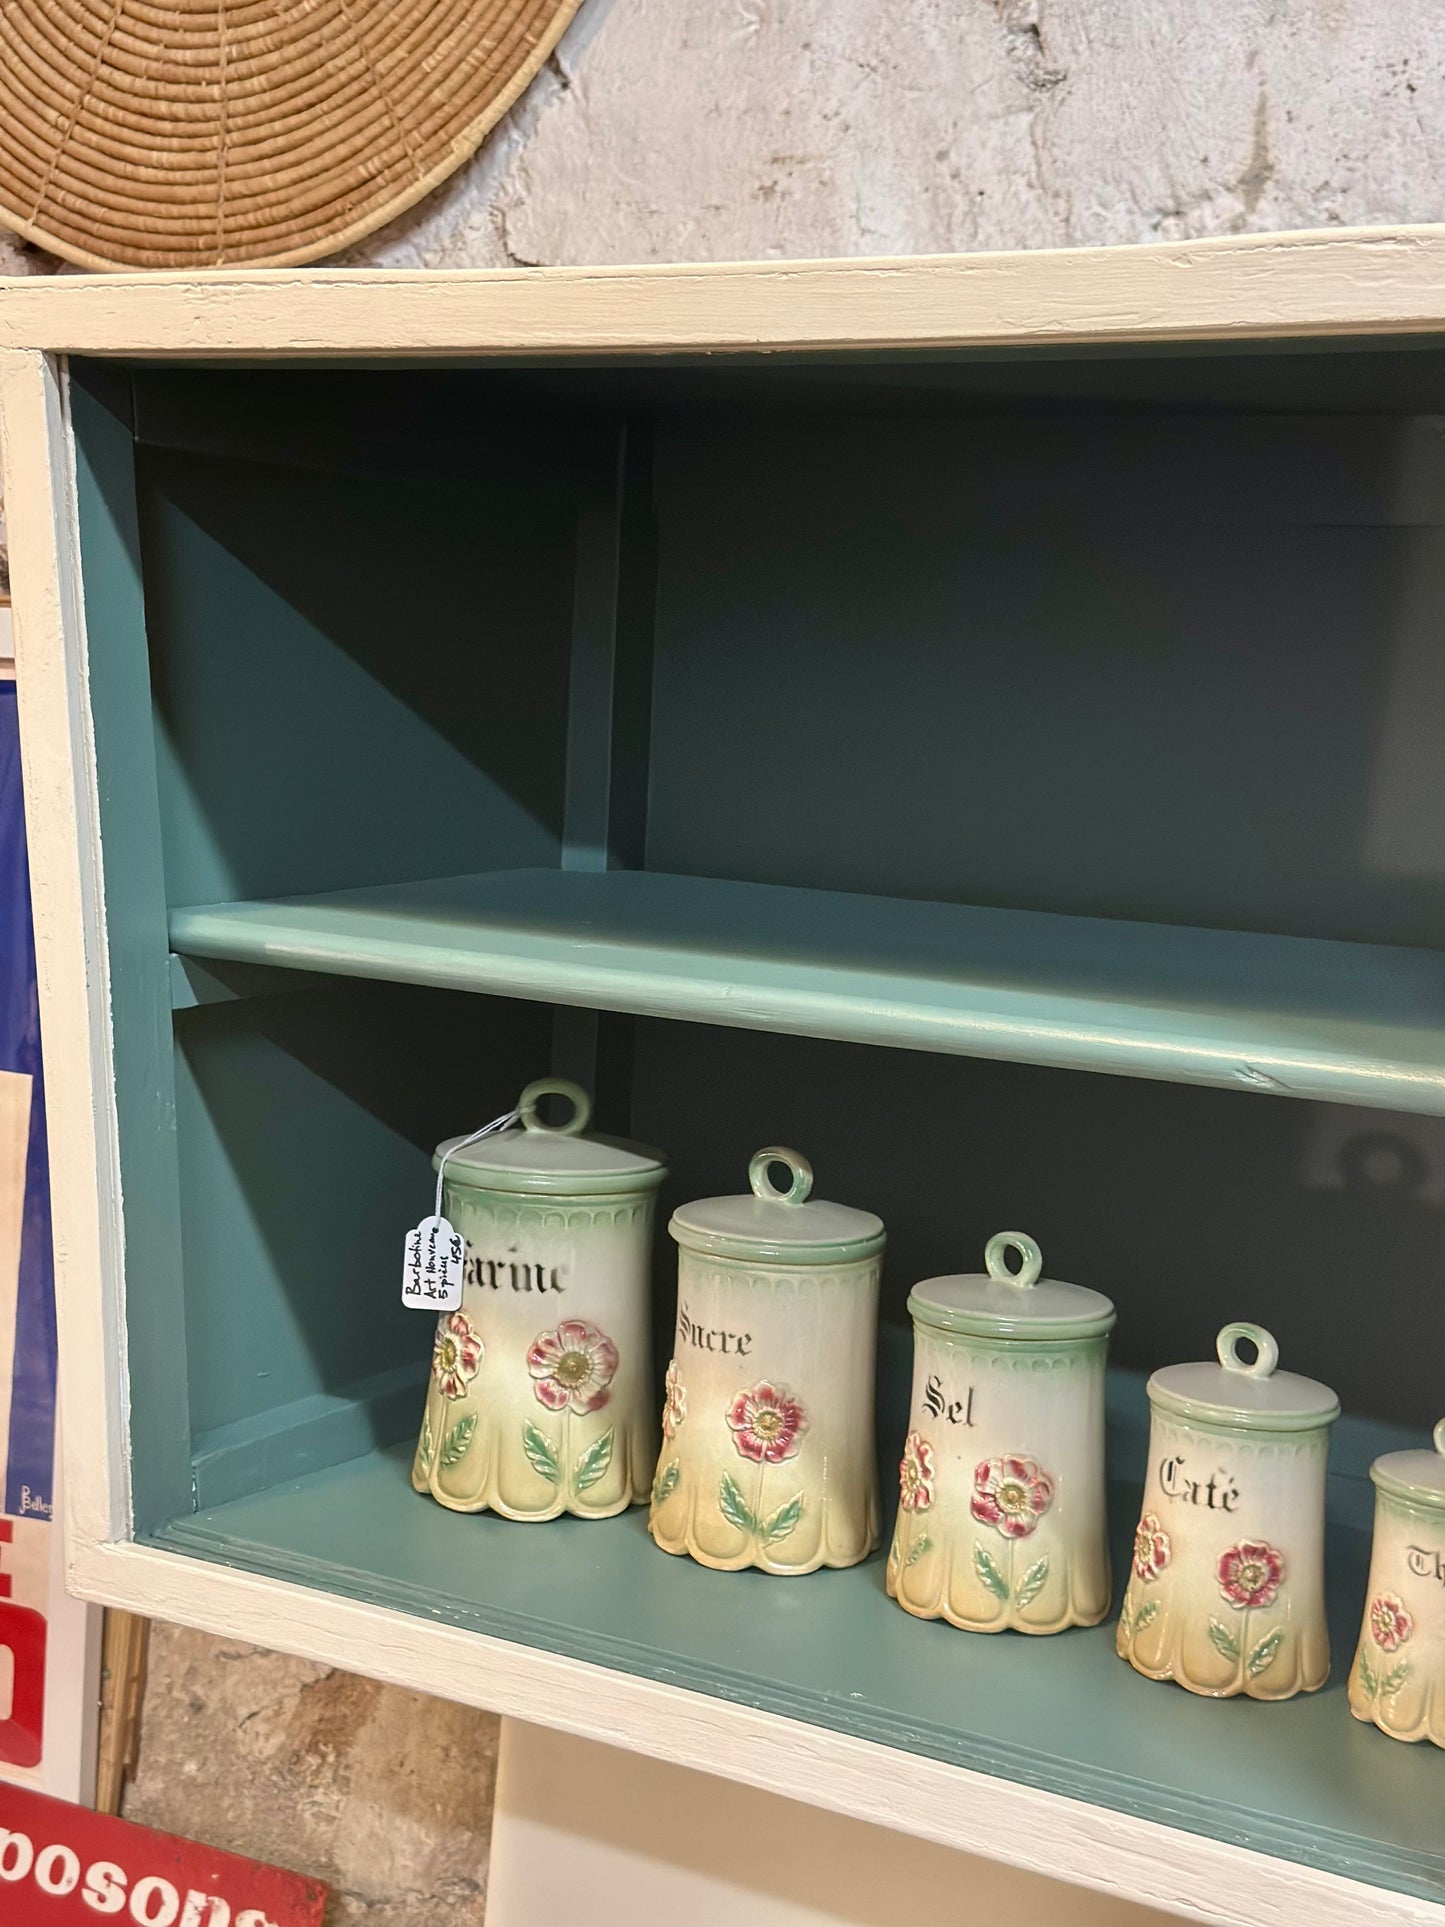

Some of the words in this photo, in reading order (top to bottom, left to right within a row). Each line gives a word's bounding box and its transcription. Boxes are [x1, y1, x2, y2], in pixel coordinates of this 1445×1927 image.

[423, 1279, 437, 1299] Art
[464, 1239, 568, 1294] arine
[438, 1289, 449, 1300] 5
[679, 1300, 752, 1357] Sucre
[921, 1374, 975, 1428] Sel
[1159, 1456, 1239, 1513] Café
